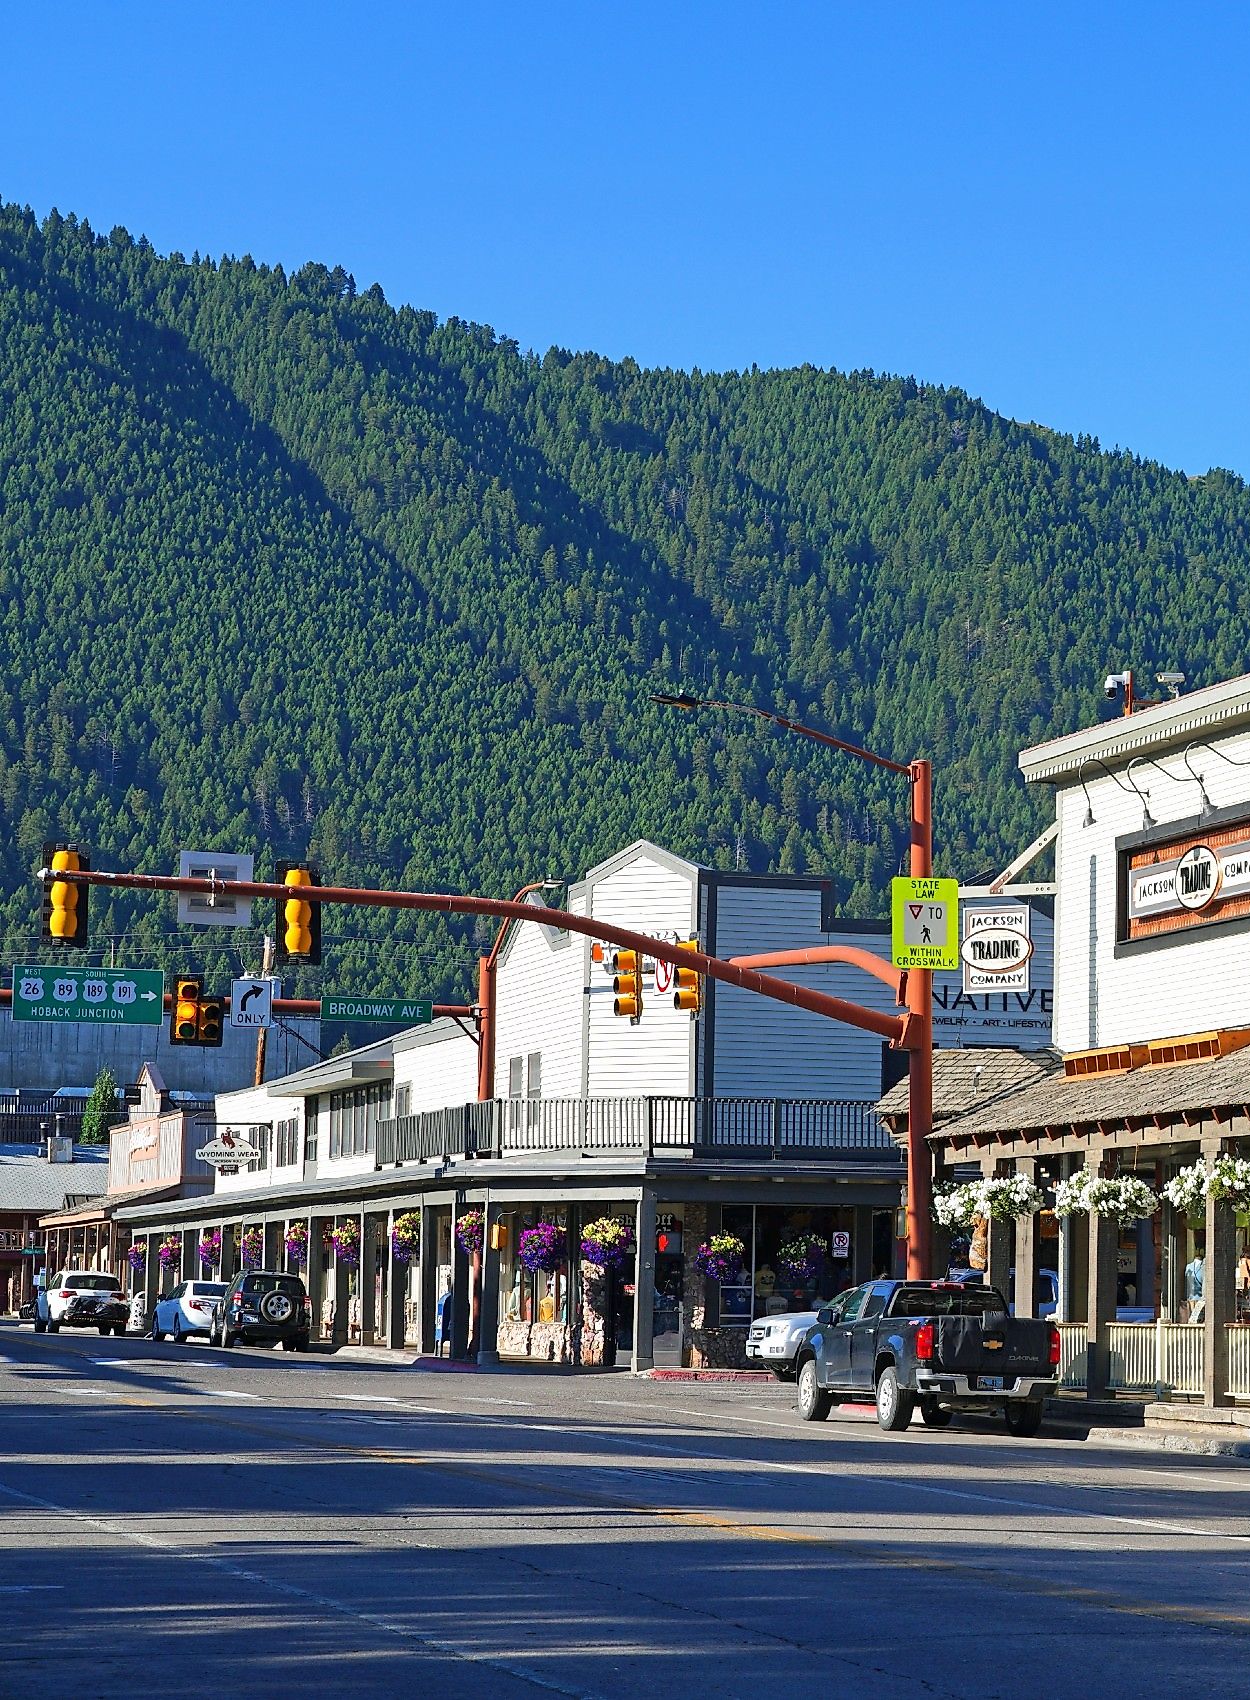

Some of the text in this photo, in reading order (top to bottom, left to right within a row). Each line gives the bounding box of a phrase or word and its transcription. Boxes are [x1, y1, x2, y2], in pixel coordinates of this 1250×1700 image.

[911, 880, 940, 889] STATE
[1139, 878, 1174, 901] JACKSON
[1180, 861, 1211, 895] TRADING
[915, 889, 935, 898] LAW
[928, 907, 943, 920] TO
[971, 915, 1023, 928] JACKSON
[910, 948, 942, 957] WITHIN
[970, 939, 1021, 960] TRADING
[896, 957, 955, 967] CROSSWALK
[970, 973, 1024, 985] COMPANY
[24, 982, 131, 998] 26 89 189 191
[31, 1006, 124, 1019] HOBACK JUNCTION
[329, 1002, 424, 1018] BROADWAY AVE
[237, 1014, 266, 1024] ONLY
[982, 1019, 1000, 1027] ART
[1008, 1020, 1052, 1028] LIFESTYL
